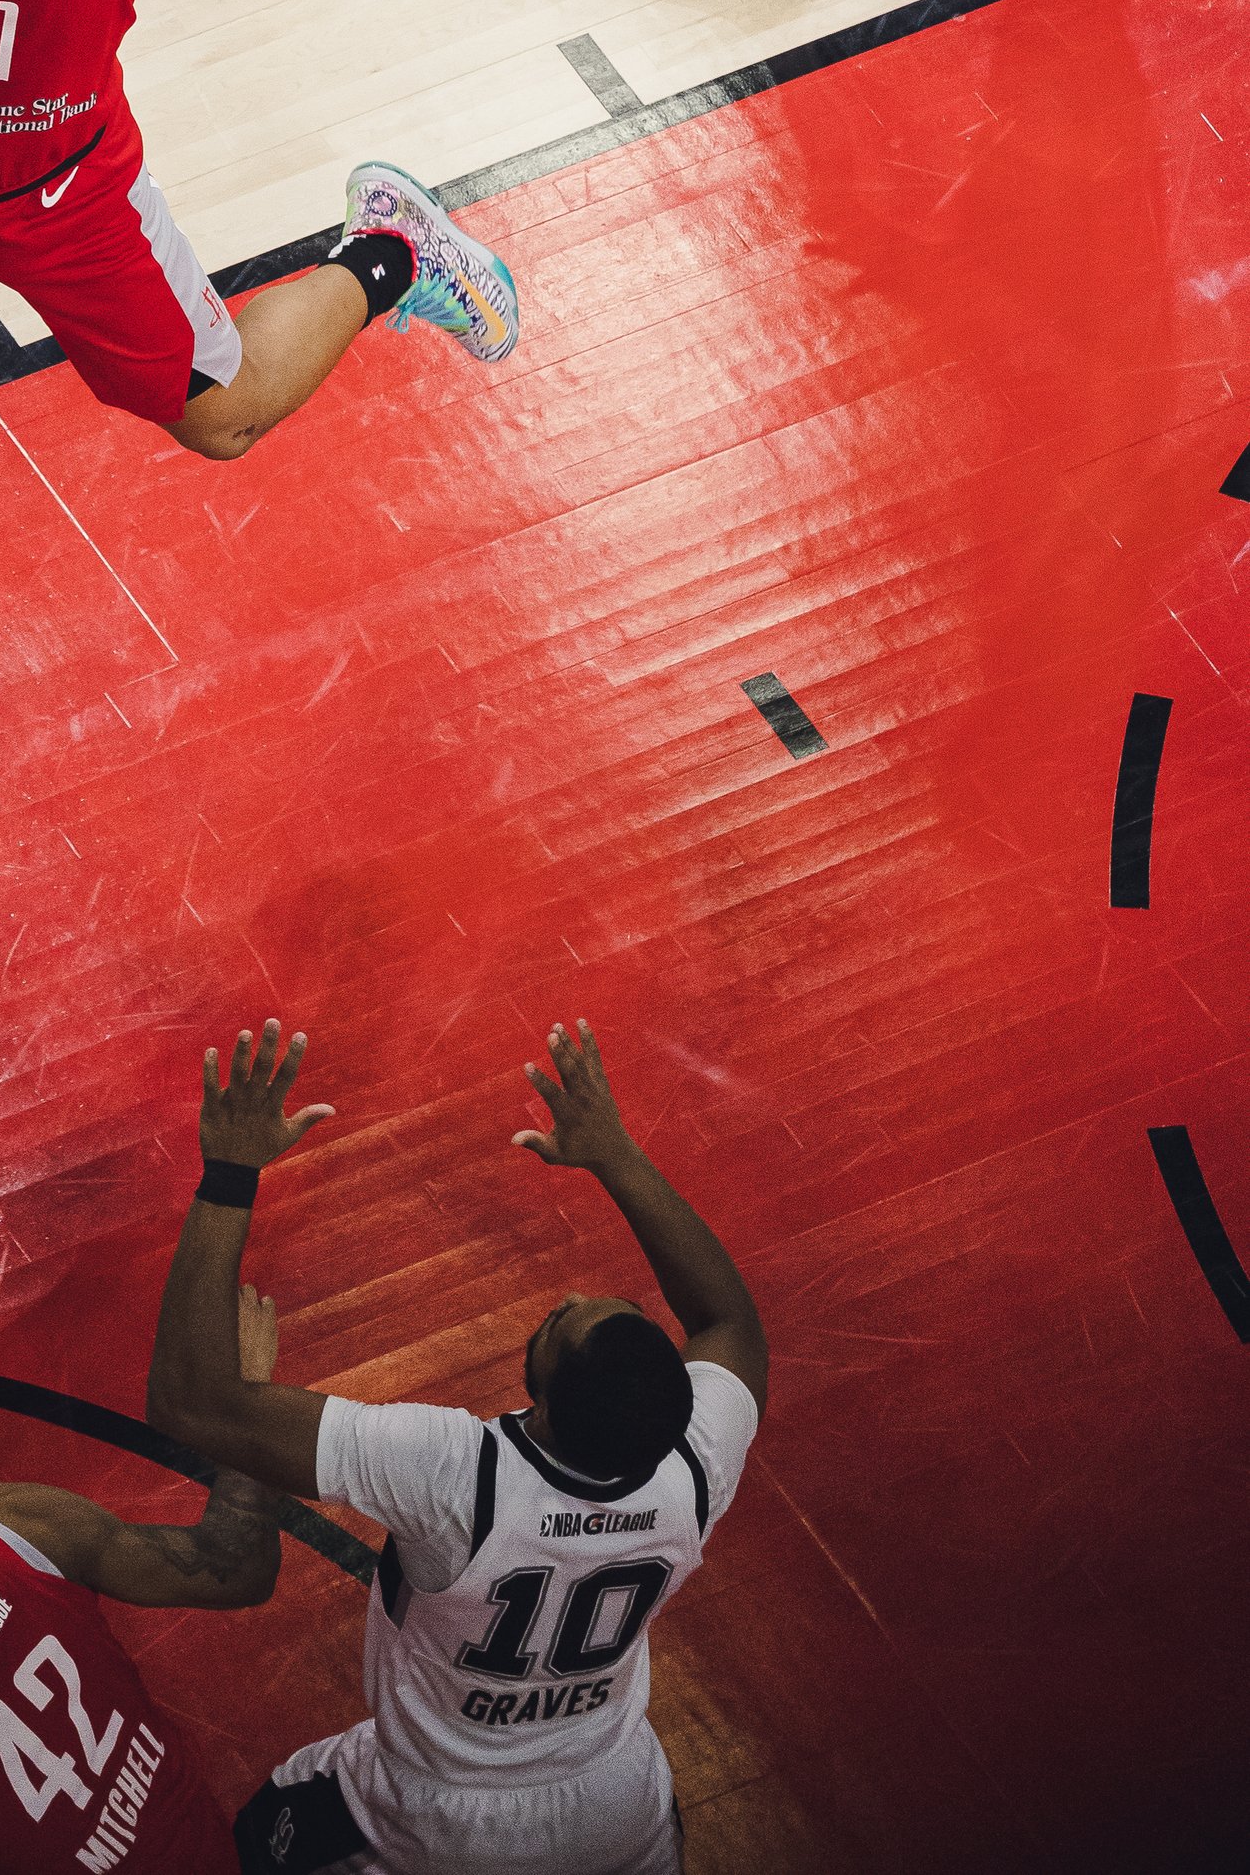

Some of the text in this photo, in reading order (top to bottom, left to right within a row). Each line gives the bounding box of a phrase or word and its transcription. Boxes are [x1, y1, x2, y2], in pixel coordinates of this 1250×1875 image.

[32, 93, 68, 116] Star
[59, 91, 97, 125] Bank
[452, 1556, 675, 1681] 10
[460, 1678, 614, 1726] GRAVES
[75, 1722, 165, 1875] MITCHELL
